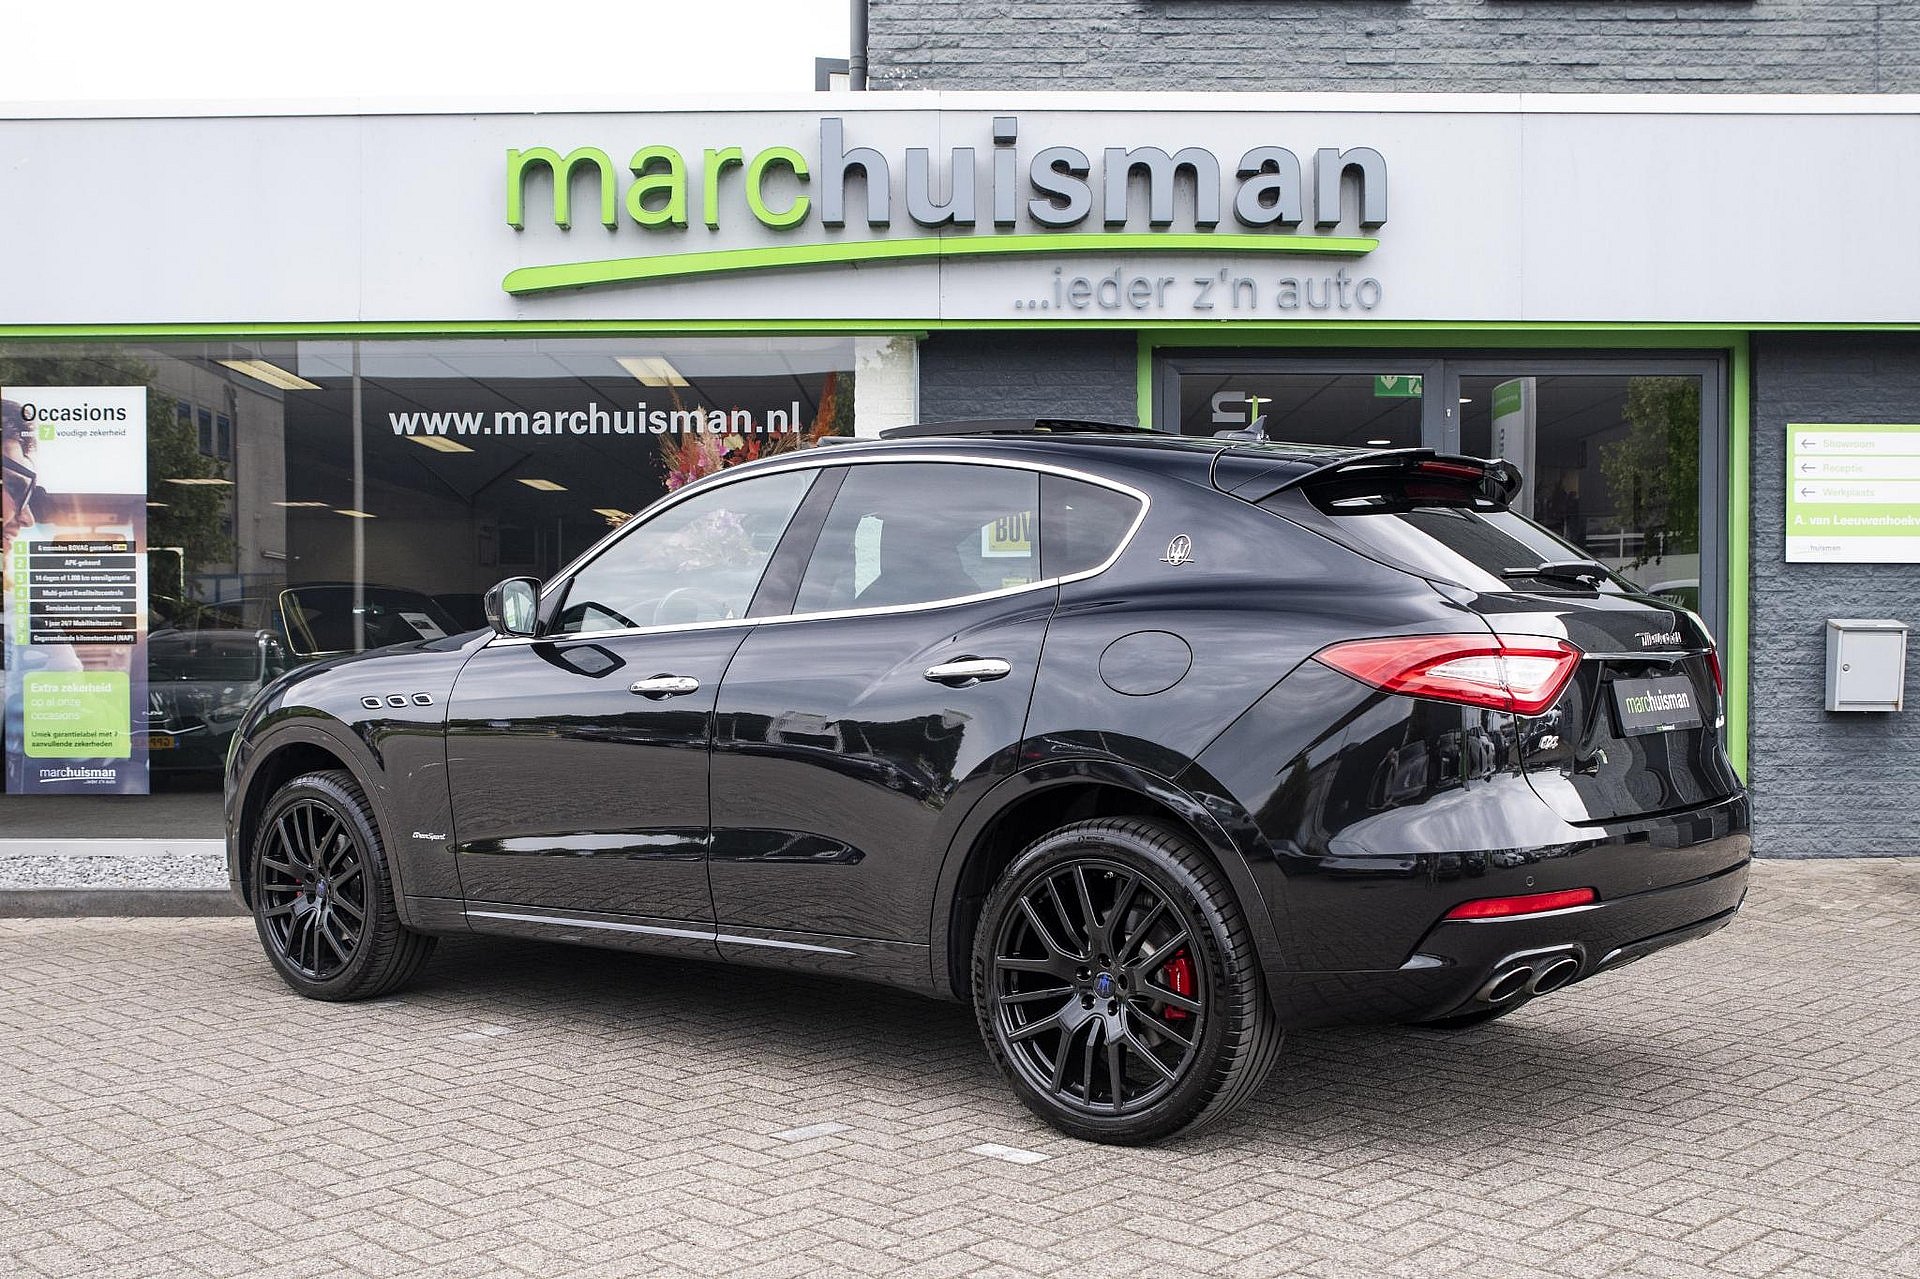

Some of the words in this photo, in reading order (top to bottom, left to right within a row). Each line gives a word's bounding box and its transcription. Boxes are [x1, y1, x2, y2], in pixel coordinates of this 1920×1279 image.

[505, 117, 1390, 231] marchuisman
[1193, 267, 1258, 311] z'n
[1276, 267, 1382, 311] auto
[21, 403, 127, 422] Occasions
[388, 401, 801, 436] www.marchuisman.nl
[57, 428, 88, 438] voudige
[89, 429, 126, 437] zekerheid
[1811, 517, 1830, 526] van
[31, 683, 58, 693] Extra
[62, 683, 112, 693] zekerheid
[1625, 689, 1691, 714] marchuisman
[53, 730, 97, 739] garantielabel
[40, 766, 116, 778] marchuisman
